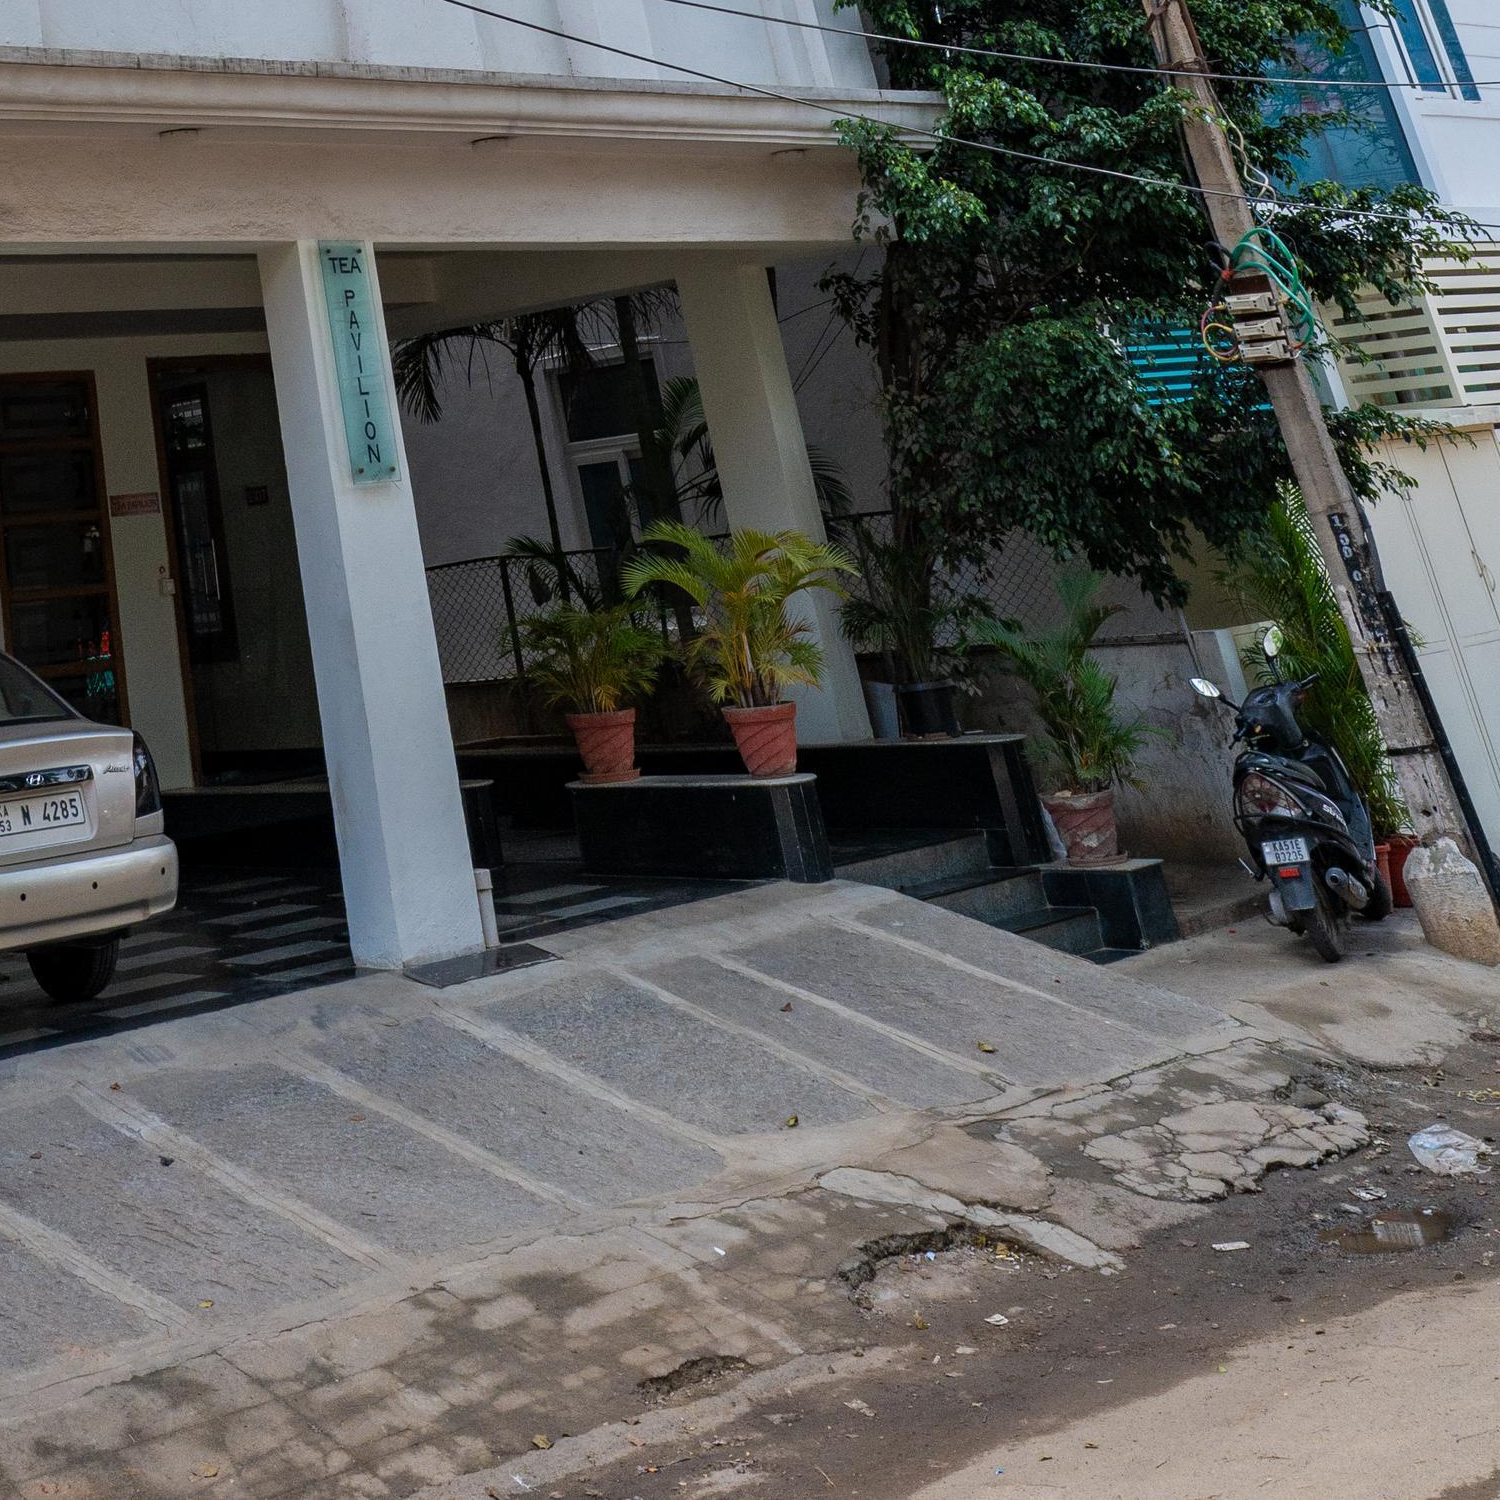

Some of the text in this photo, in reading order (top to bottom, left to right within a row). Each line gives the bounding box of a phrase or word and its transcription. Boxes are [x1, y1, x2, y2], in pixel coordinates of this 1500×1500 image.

[328, 257, 361, 274] TEA
[345, 290, 381, 464] PAVILION
[21, 805, 32, 826] N
[42, 798, 79, 822] 4285
[0, 820, 12, 833] 53
[1272, 840, 1301, 852] KA51E
